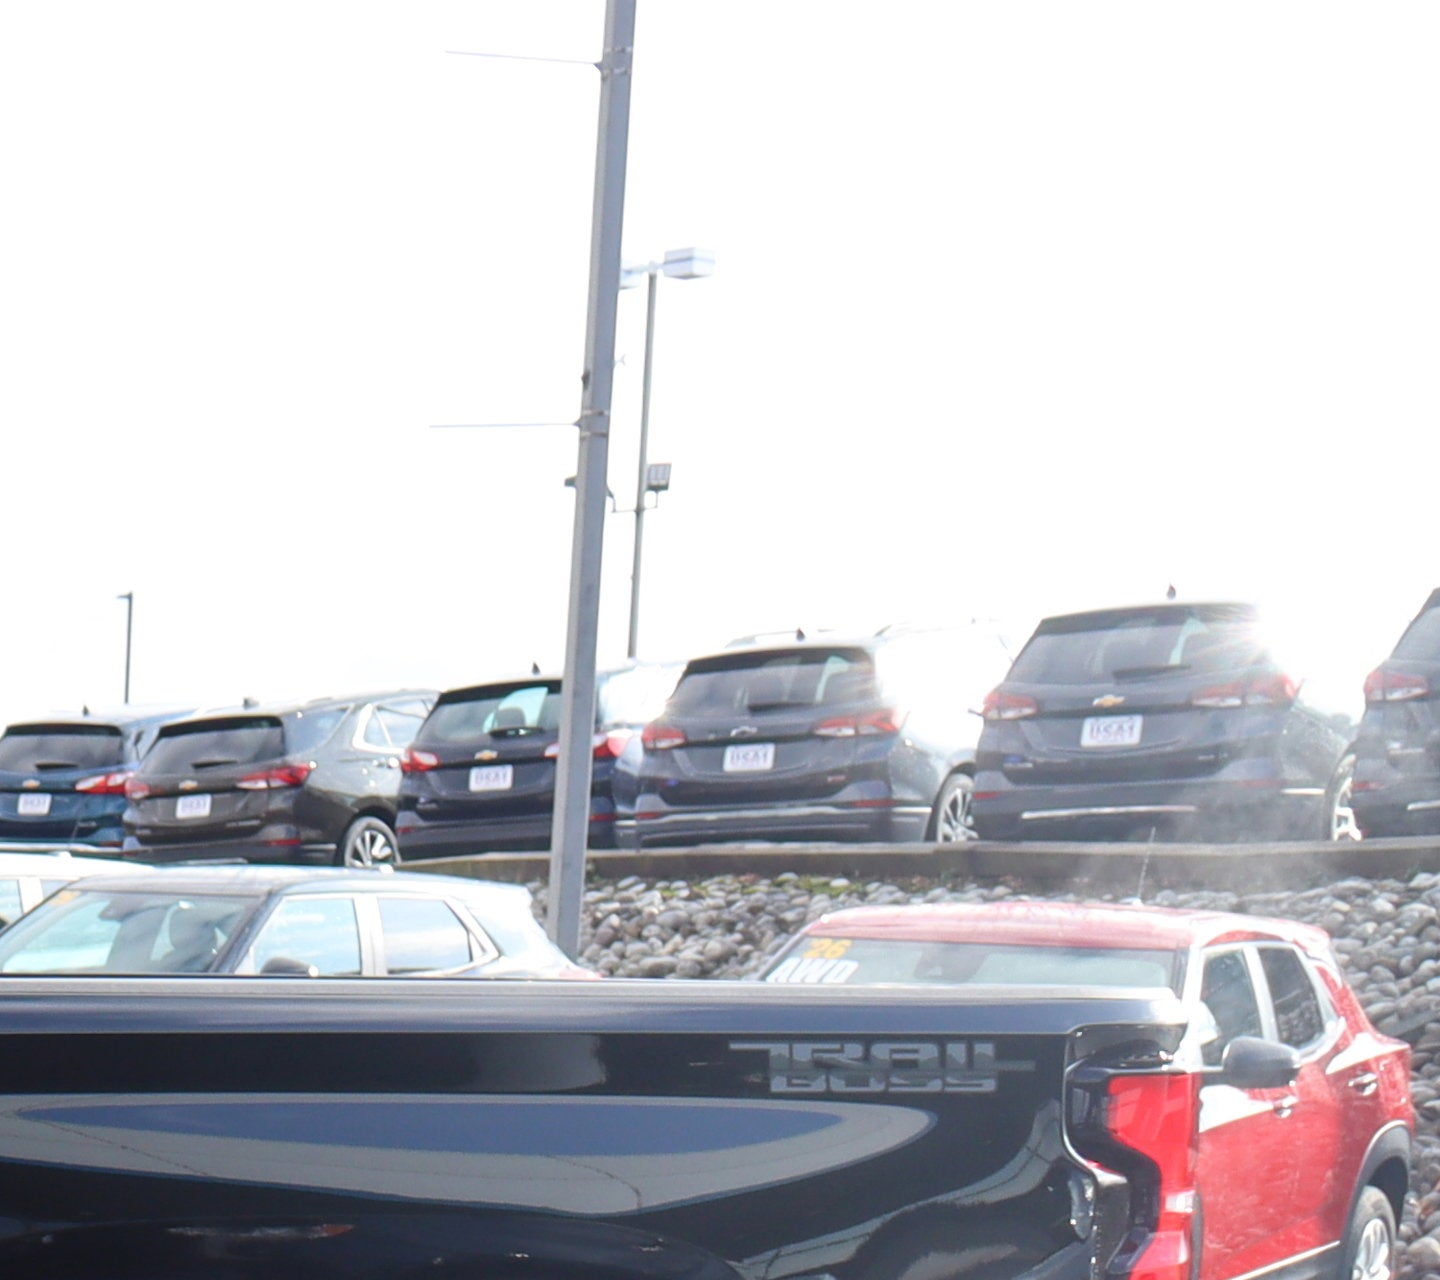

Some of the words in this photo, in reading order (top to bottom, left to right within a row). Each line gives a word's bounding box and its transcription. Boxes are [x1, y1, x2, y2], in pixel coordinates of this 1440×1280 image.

[765, 957, 859, 983] AWD
[729, 1042, 1037, 1072] TRAIL
[770, 1072, 996, 1093] BOSS
